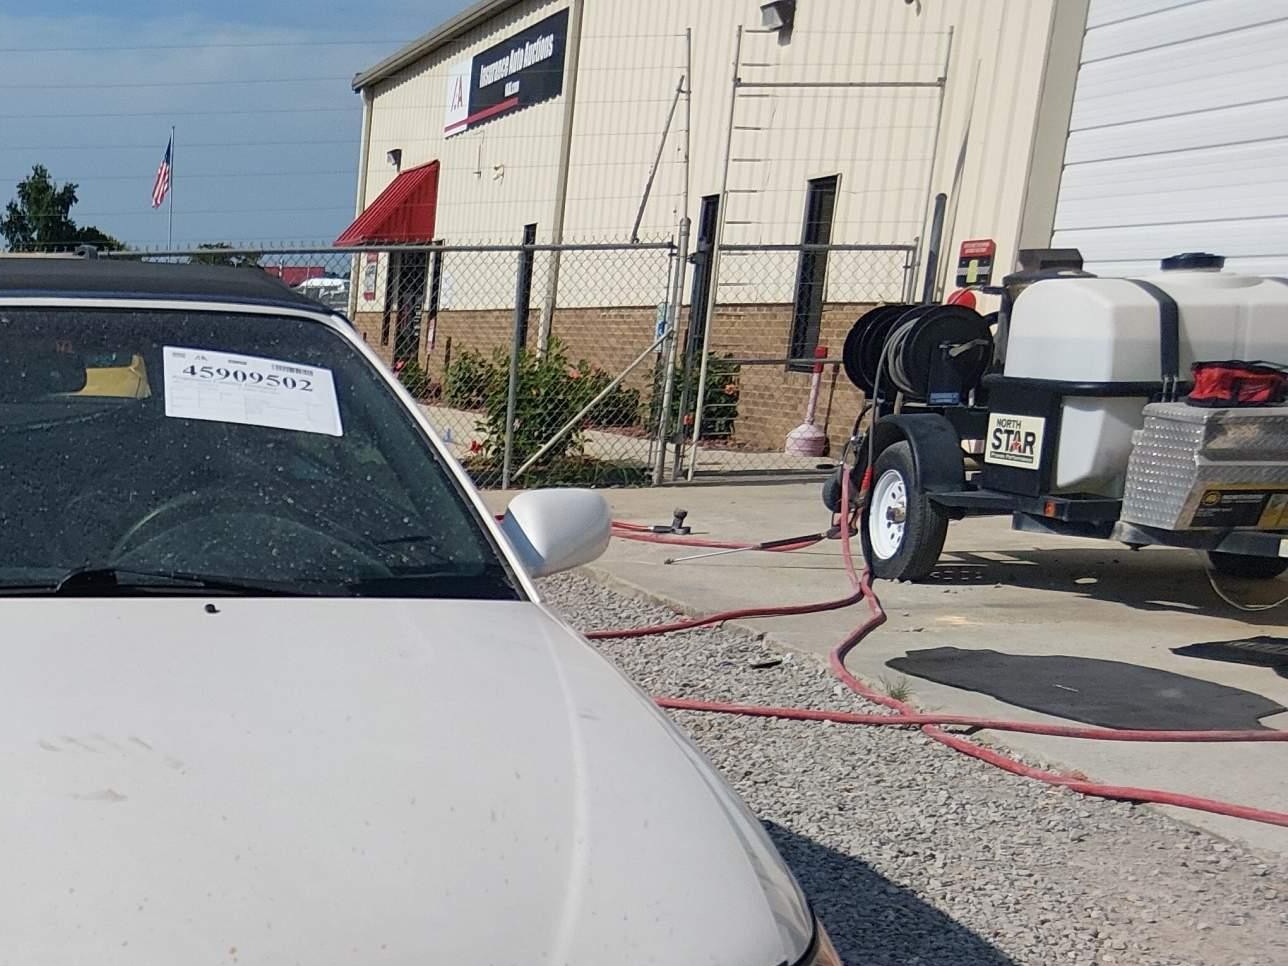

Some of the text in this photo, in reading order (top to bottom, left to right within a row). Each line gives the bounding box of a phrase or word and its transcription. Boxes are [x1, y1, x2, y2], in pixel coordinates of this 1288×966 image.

[480, 34, 554, 88] Insurance Auto Auctions
[182, 364, 313, 392] 45909502
[996, 418, 1022, 429] NORTH
[991, 427, 1036, 455] STAR
